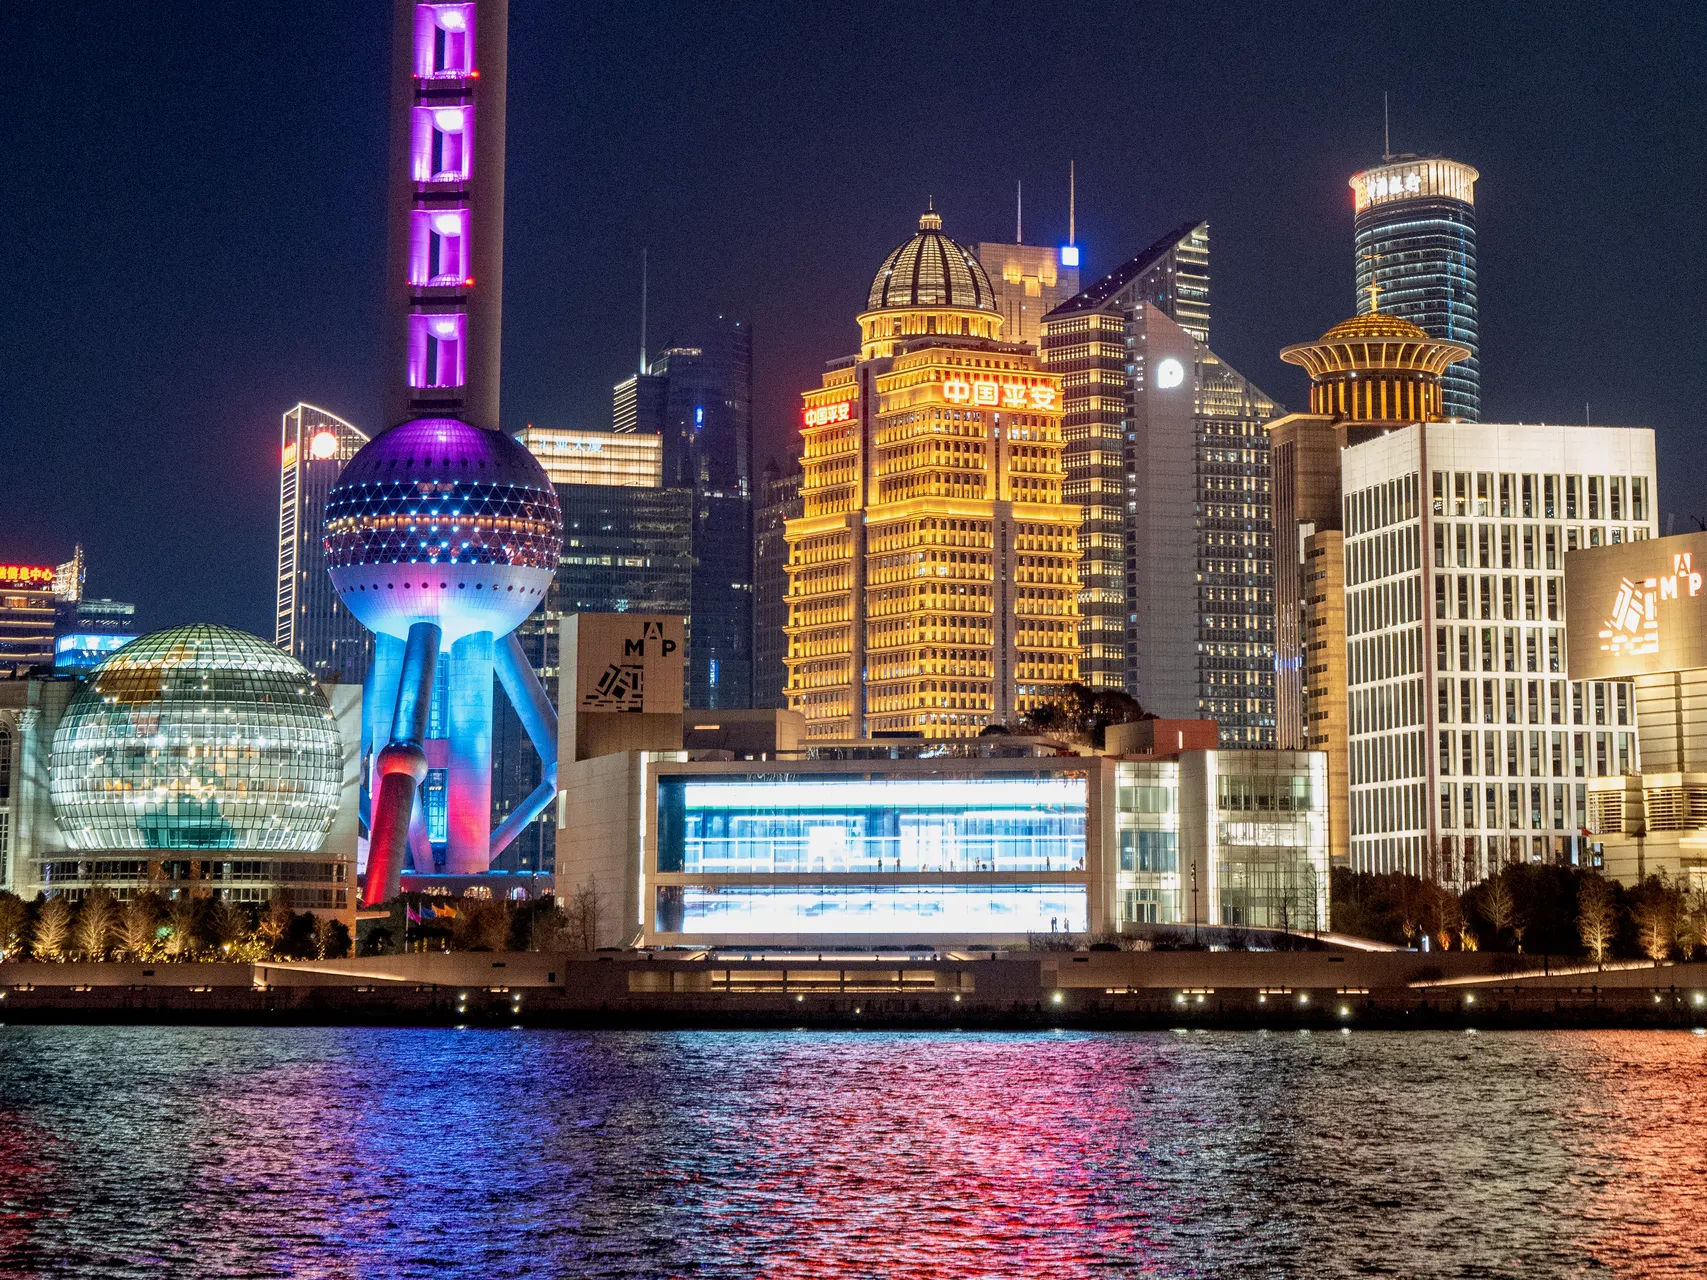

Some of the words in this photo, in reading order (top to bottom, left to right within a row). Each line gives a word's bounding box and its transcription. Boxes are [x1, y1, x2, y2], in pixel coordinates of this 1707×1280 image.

[944, 380, 1055, 410] 中国平安
[805, 402, 850, 427] 中国平安
[624, 621, 677, 657] MAP
